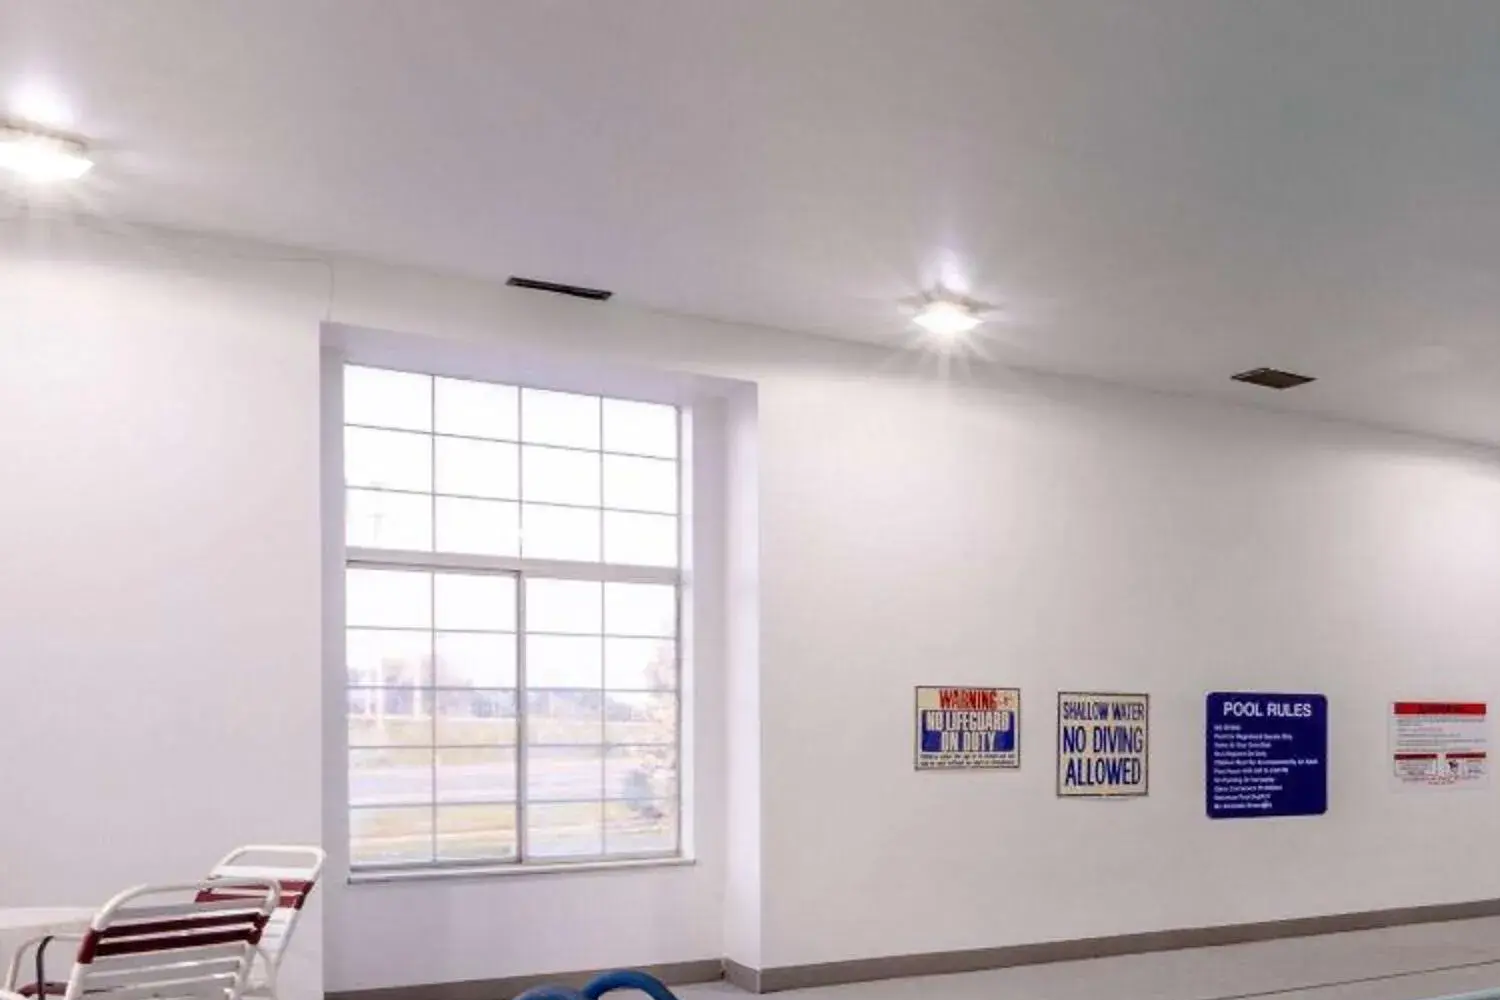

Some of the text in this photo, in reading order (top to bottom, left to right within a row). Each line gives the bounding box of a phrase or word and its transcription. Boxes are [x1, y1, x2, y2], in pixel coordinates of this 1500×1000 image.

[939, 689, 997, 709] WARNING
[1223, 701, 1312, 717] POOL RULES
[926, 711, 1009, 732] NO LIFEGUARD
[1063, 701, 1144, 721] SHALLOW WATER
[941, 731, 995, 752] ON DUTY
[1063, 726, 1143, 754] NO DIVING
[1065, 757, 1141, 786] ALLOWED
